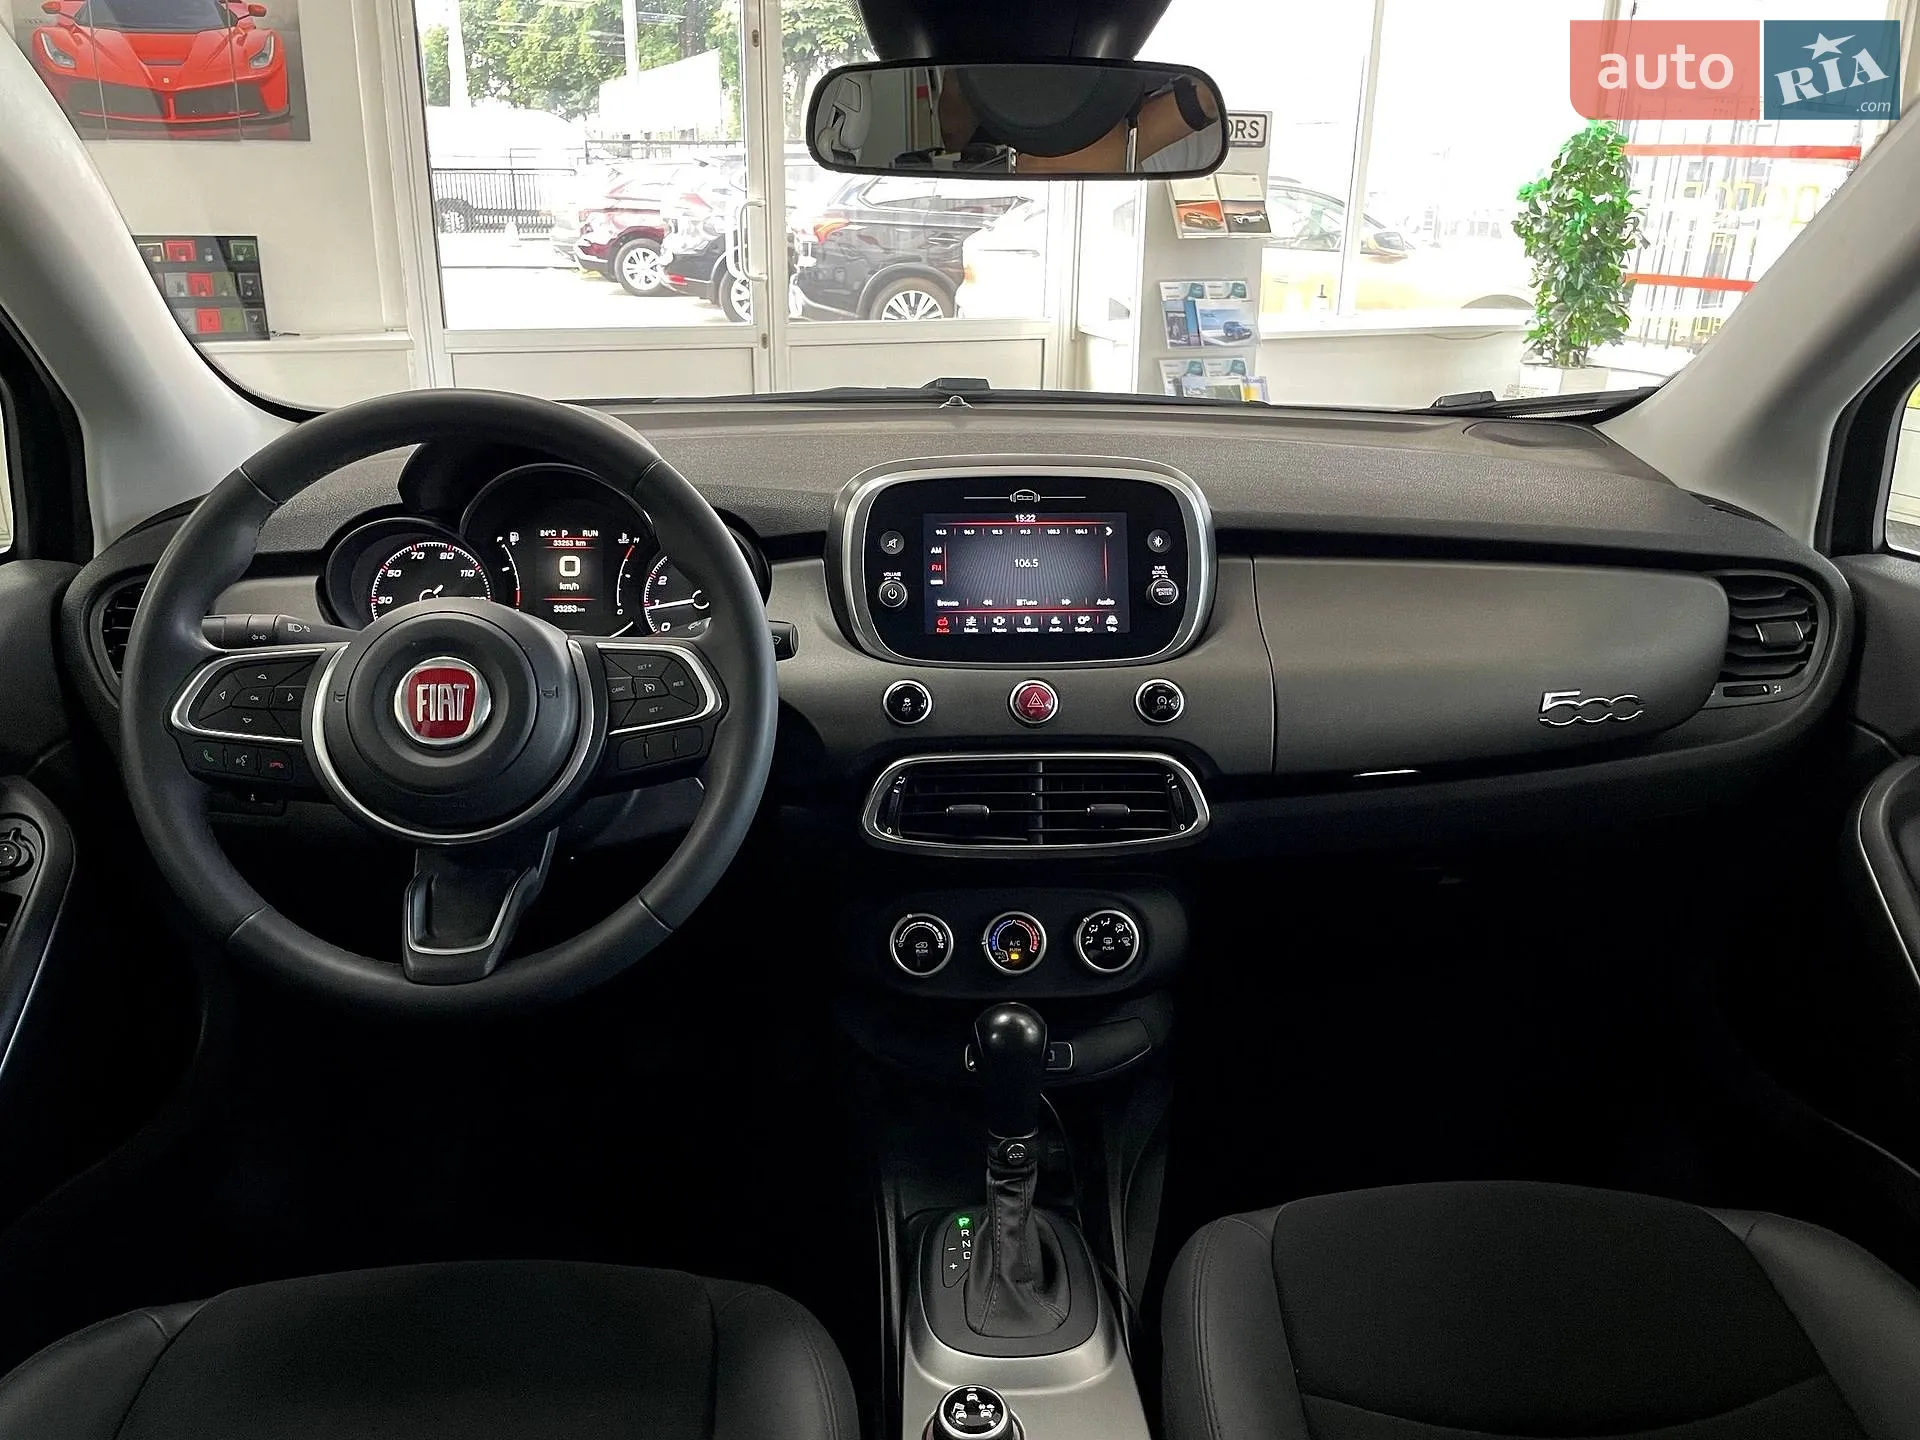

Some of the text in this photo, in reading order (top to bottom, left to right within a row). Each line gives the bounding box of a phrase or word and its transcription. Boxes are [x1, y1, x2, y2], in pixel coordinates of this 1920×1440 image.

[1015, 514, 1036, 523] 15:22
[562, 530, 569, 538] P
[930, 546, 943, 554] AM
[410, 551, 425, 560] 70
[1014, 558, 1039, 568] 106.5
[387, 569, 402, 578] 50
[460, 569, 475, 578] 110
[657, 575, 668, 585] 2
[559, 582, 580, 591] km/h
[377, 596, 393, 604] 30
[937, 599, 960, 607] Browse
[1096, 598, 1115, 606] Audio
[661, 622, 671, 632] 0
[416, 683, 470, 722] FIAT
[1538, 690, 1645, 728] 500
[960, 1229, 970, 1237] R
[961, 1239, 971, 1249] N
